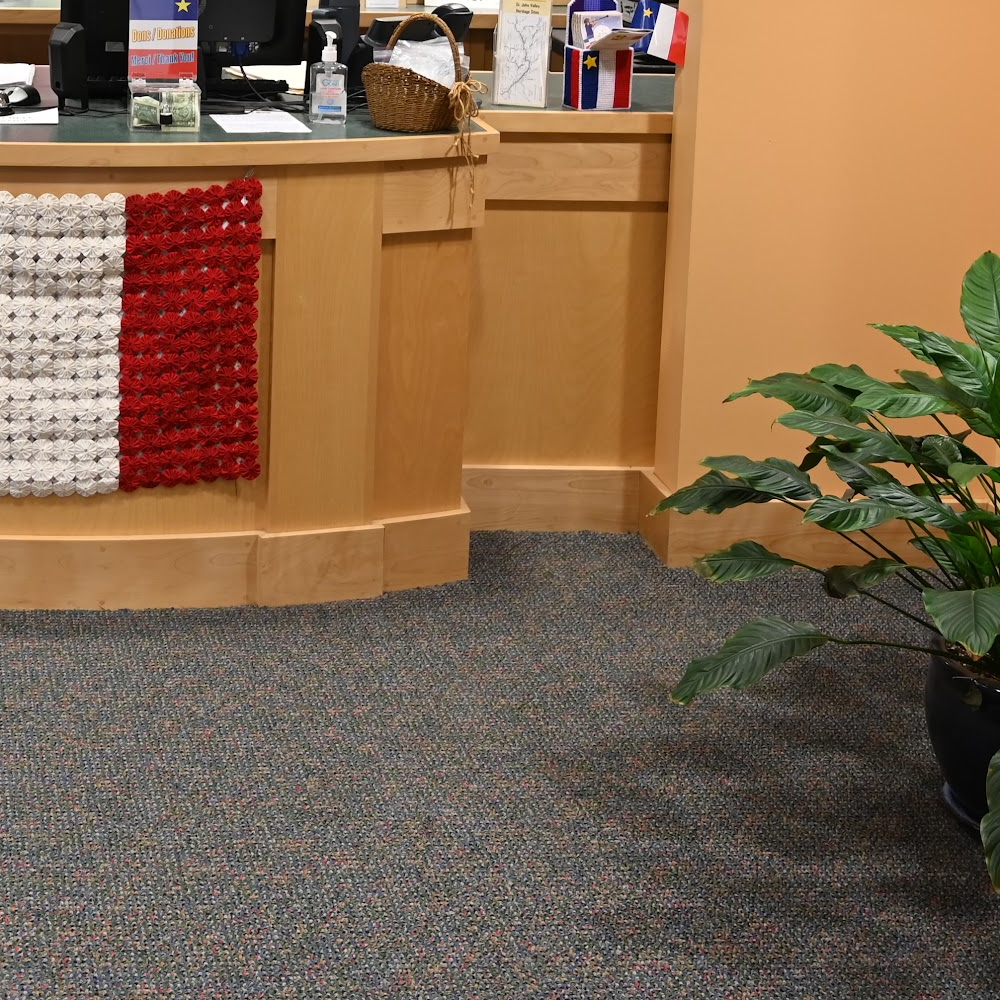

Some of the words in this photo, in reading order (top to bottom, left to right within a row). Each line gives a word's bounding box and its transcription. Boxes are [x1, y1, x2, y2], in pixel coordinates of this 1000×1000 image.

[132, 29, 152, 42] Dons
[157, 26, 195, 41] Donations
[131, 53, 152, 66] Merci
[156, 52, 179, 65] Thank
[179, 51, 195, 64] You!
